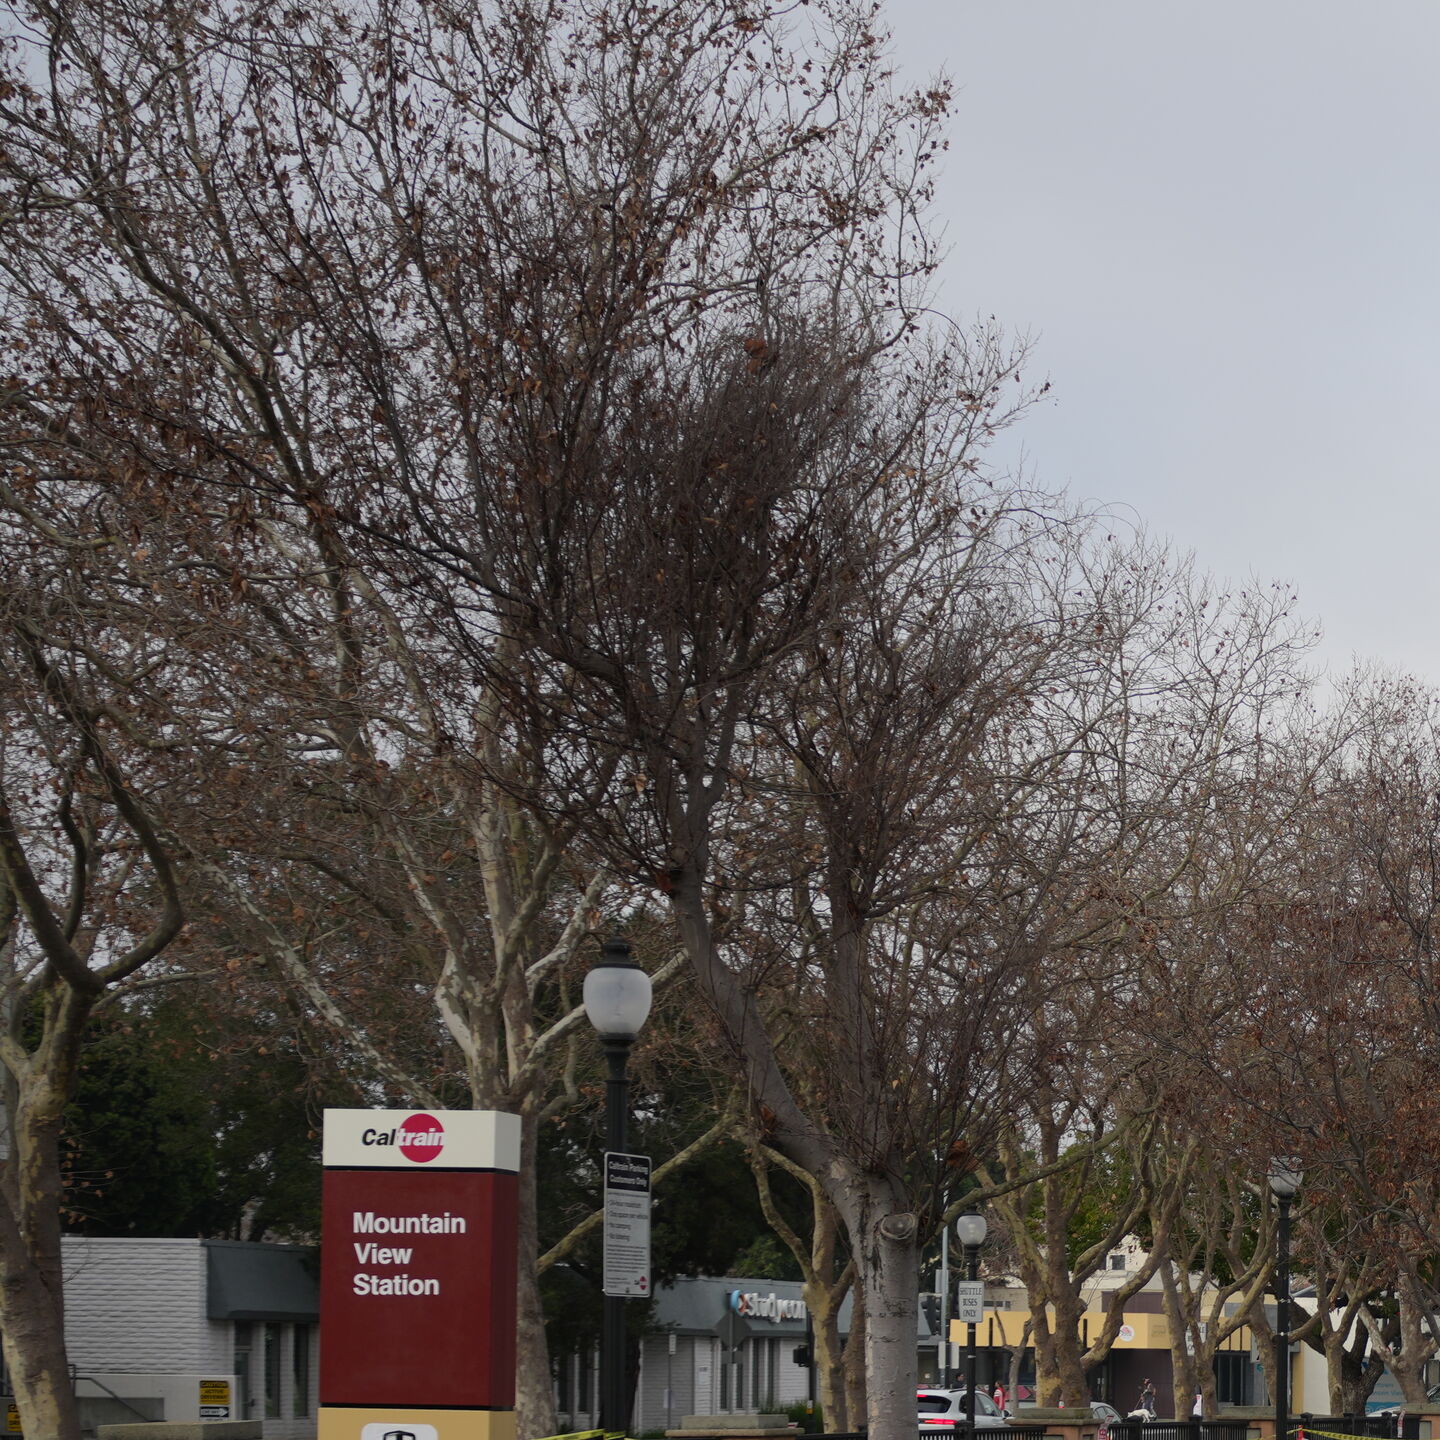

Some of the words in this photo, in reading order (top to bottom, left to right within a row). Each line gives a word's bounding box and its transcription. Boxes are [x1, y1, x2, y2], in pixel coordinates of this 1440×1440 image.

[361, 1128, 444, 1146] Caltrain
[353, 1212, 466, 1233] Mountain
[353, 1242, 413, 1264] View
[353, 1273, 440, 1295] Station
[960, 1287, 982, 1295] SHUTTLE
